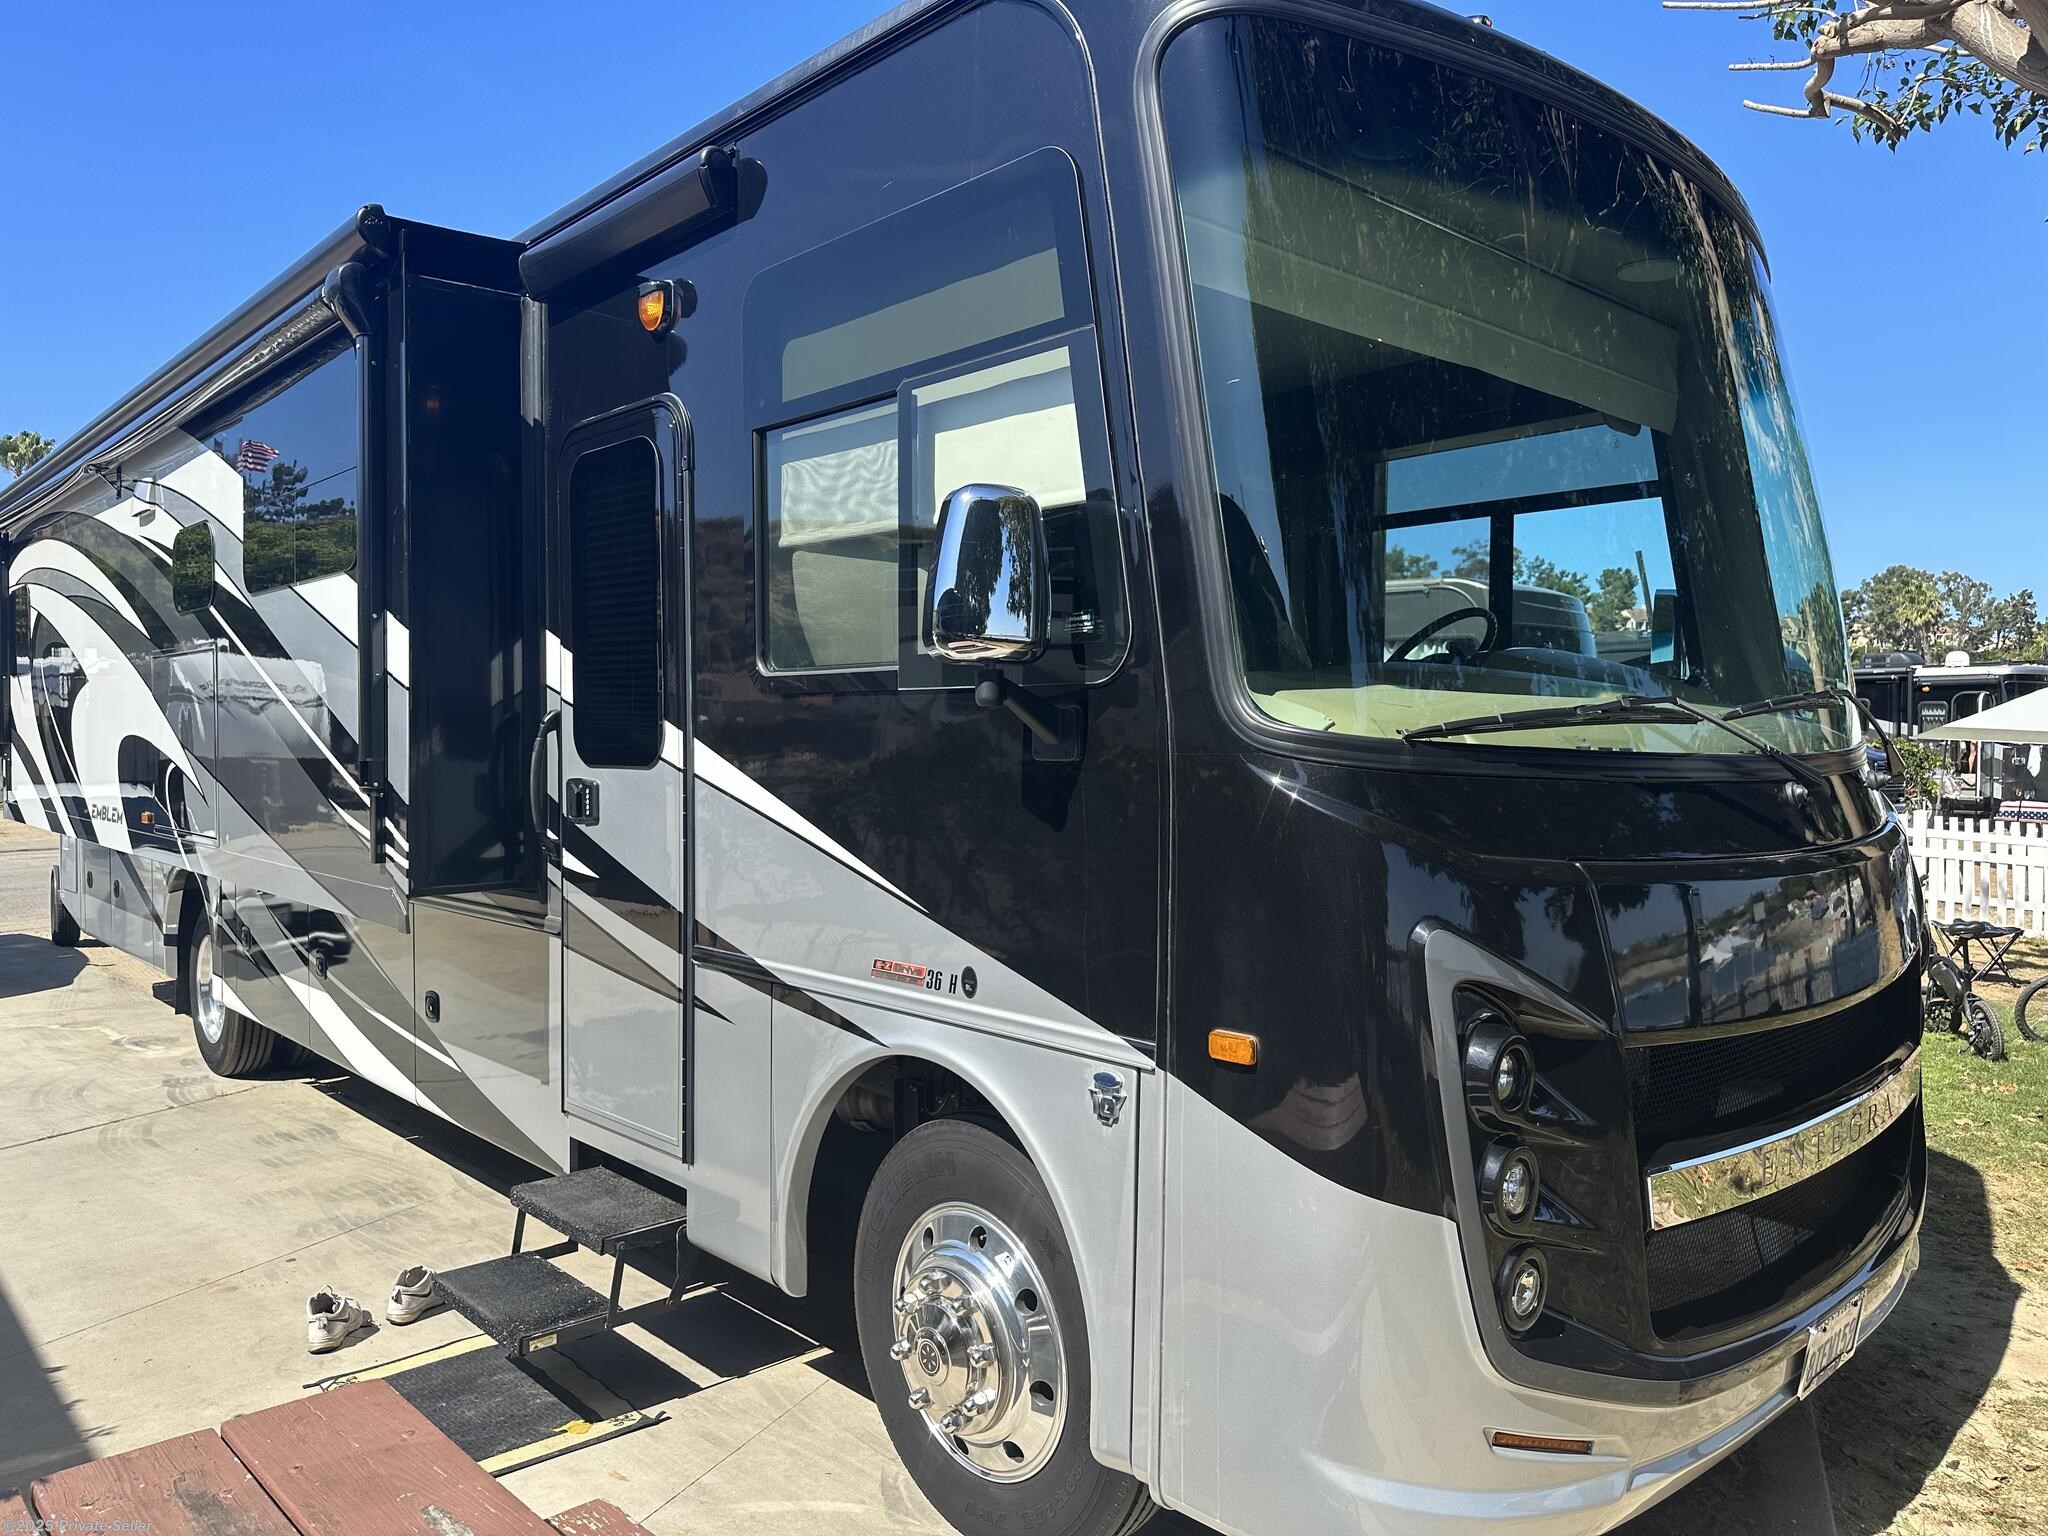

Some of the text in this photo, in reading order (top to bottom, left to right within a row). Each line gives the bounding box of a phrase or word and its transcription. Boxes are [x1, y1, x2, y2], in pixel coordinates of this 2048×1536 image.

[91, 803, 124, 825] EMBLEM
[926, 969, 943, 991] 36
[949, 973, 958, 994] H
[1759, 1093, 1893, 1187] ENTEGRA
[859, 1151, 958, 1284] MICHELIN
